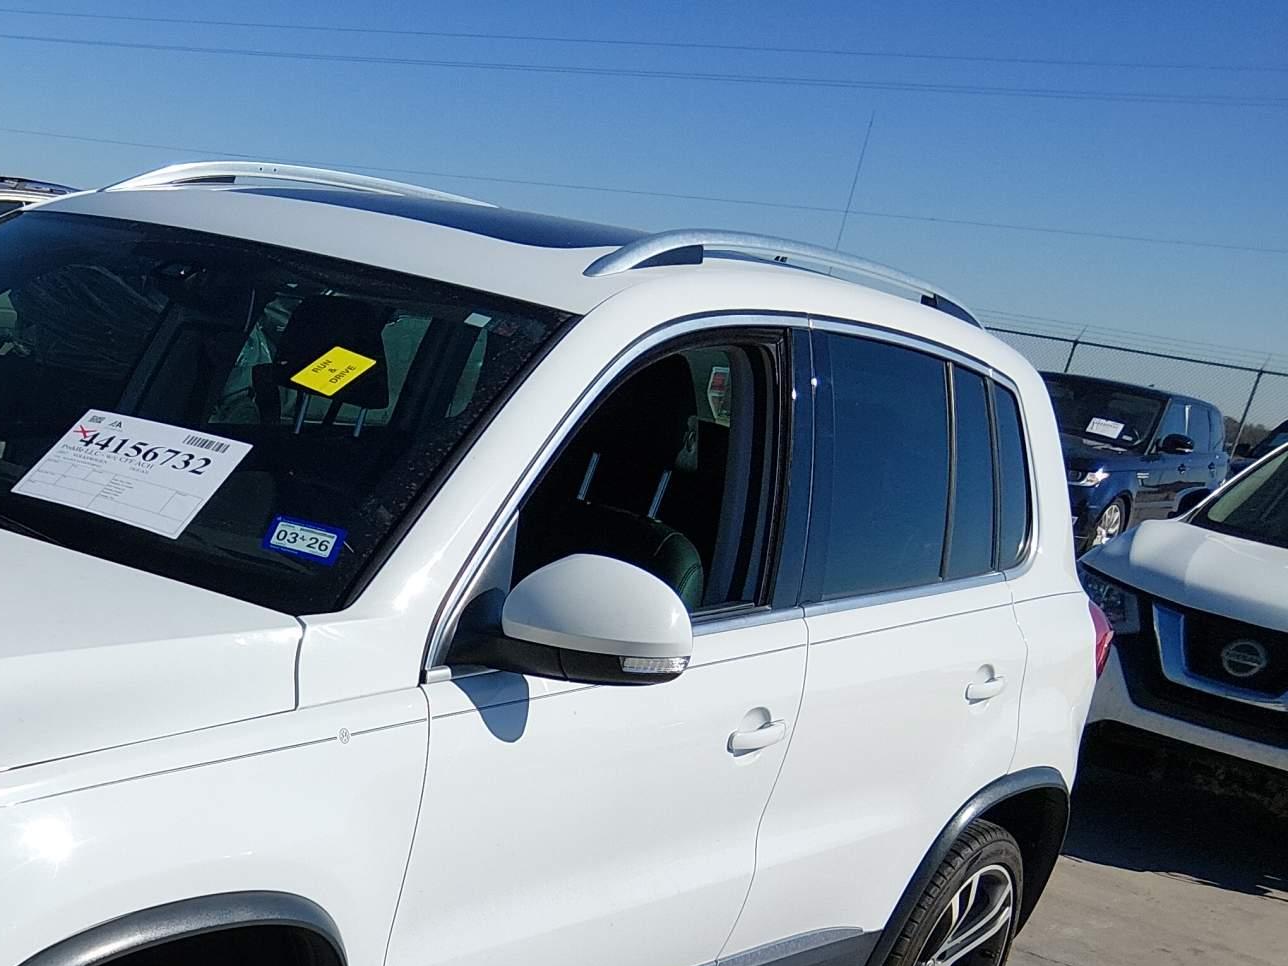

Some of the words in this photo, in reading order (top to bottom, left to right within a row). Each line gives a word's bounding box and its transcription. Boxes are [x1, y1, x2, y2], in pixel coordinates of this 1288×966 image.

[312, 359, 332, 373] RUN
[329, 365, 356, 384] DRIVE
[79, 432, 212, 475] 44156732
[276, 529, 299, 544] 03
[306, 536, 330, 552] 26
